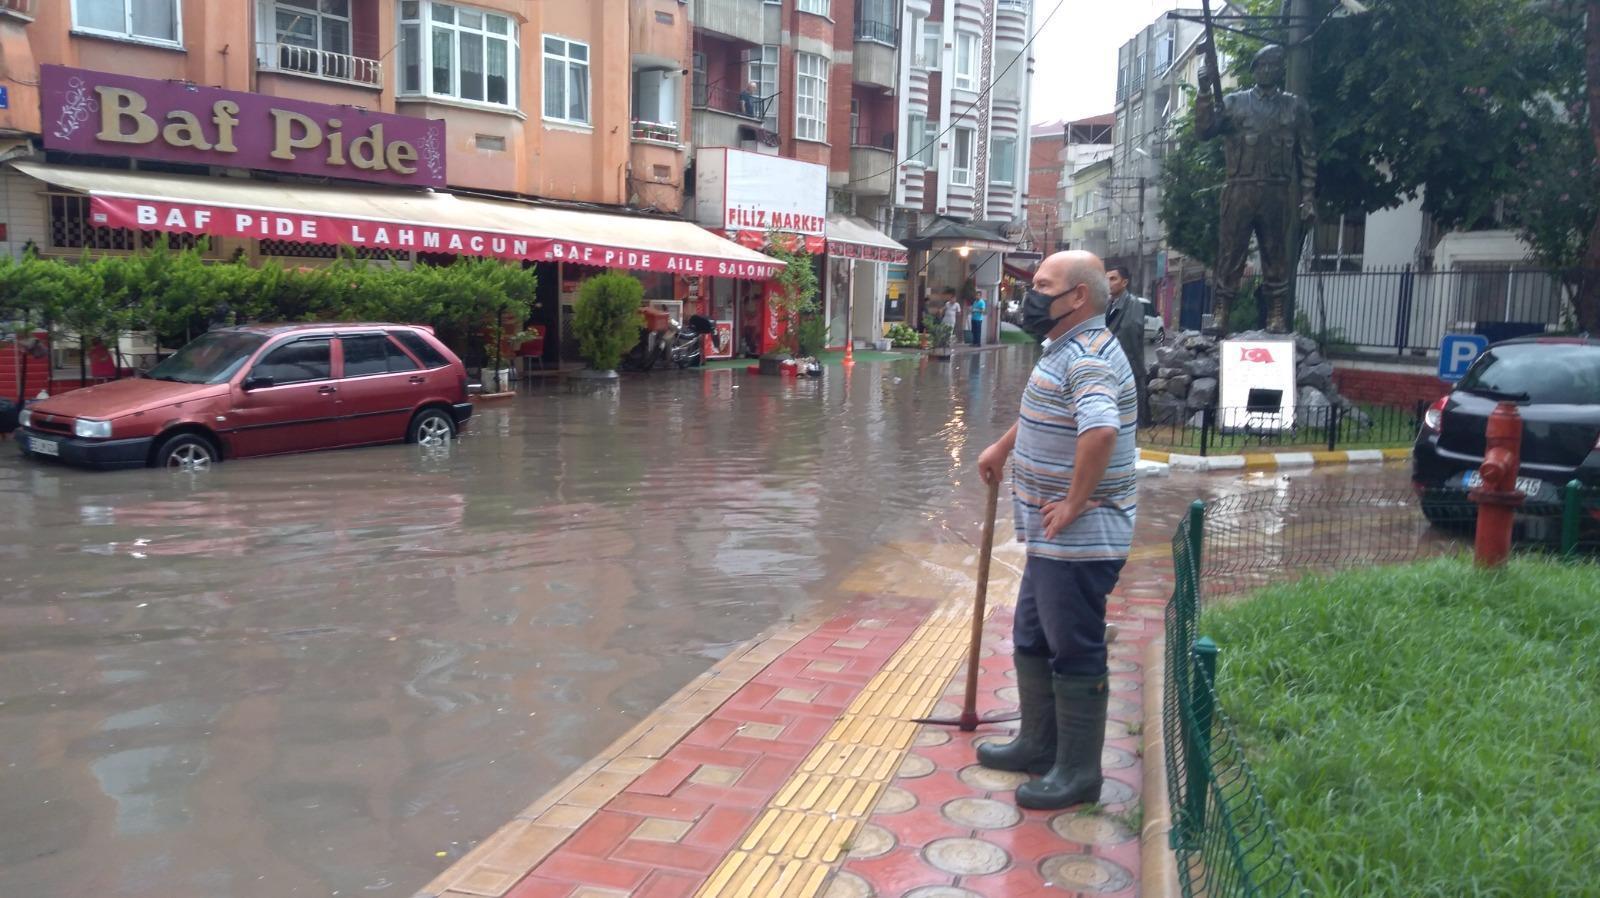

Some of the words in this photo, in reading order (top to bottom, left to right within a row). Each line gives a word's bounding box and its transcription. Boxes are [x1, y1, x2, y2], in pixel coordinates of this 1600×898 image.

[94, 85, 240, 153] Baf
[270, 108, 419, 175] Pide
[137, 205, 211, 229] BAF
[352, 225, 528, 255] LAHMACUN
[729, 204, 766, 228] FİLİZ
[772, 211, 825, 233] MARKET
[553, 243, 593, 261] BAF
[718, 262, 775, 278] SALONU
[1449, 341, 1478, 373] P
